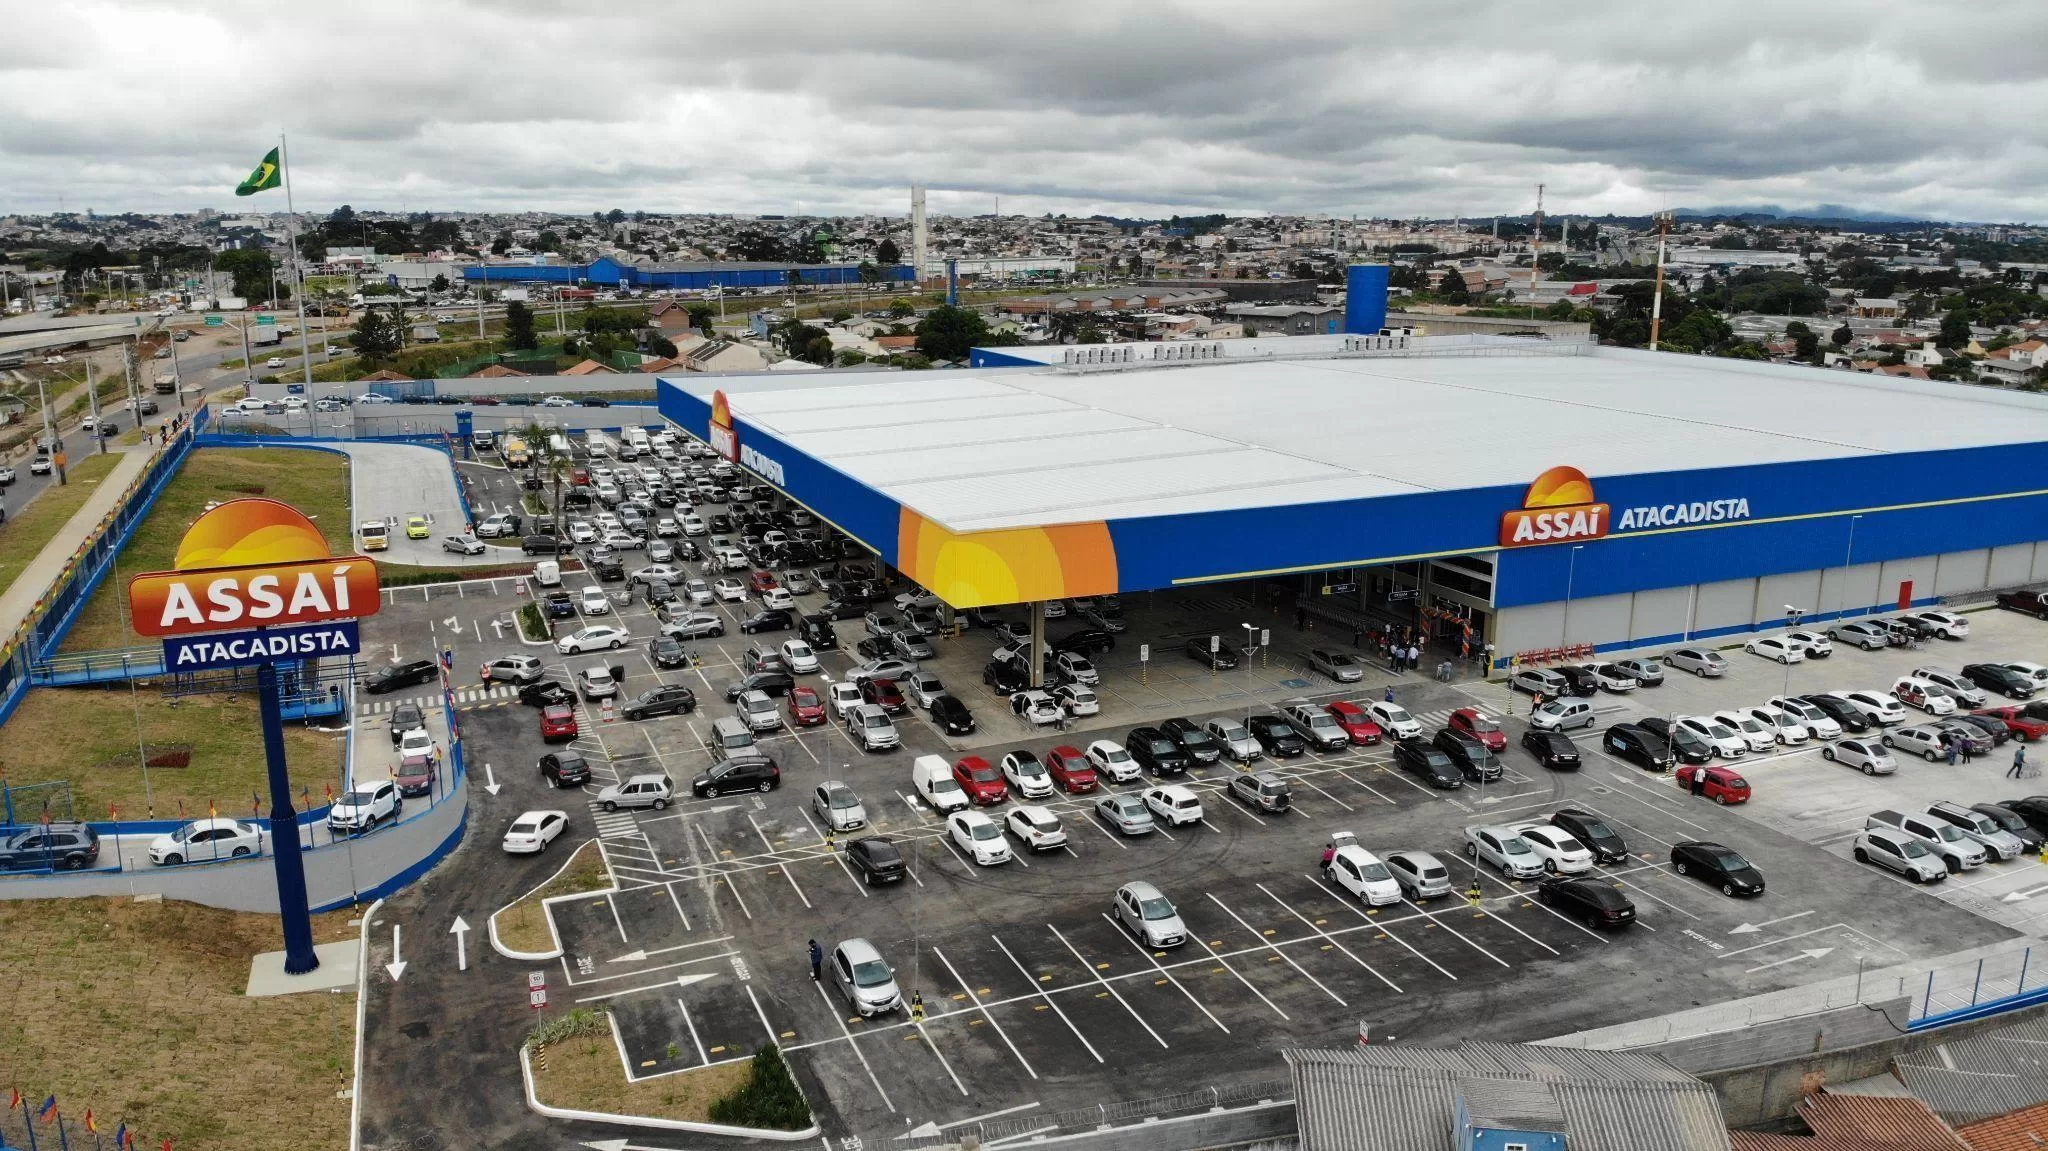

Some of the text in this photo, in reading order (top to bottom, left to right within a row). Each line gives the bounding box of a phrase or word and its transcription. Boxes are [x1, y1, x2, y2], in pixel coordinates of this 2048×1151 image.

[1513, 498, 1750, 542] ASSAÍ ATACADISTA
[160, 565, 351, 627] ASSAÍ
[177, 630, 350, 665] ATACADISTA
